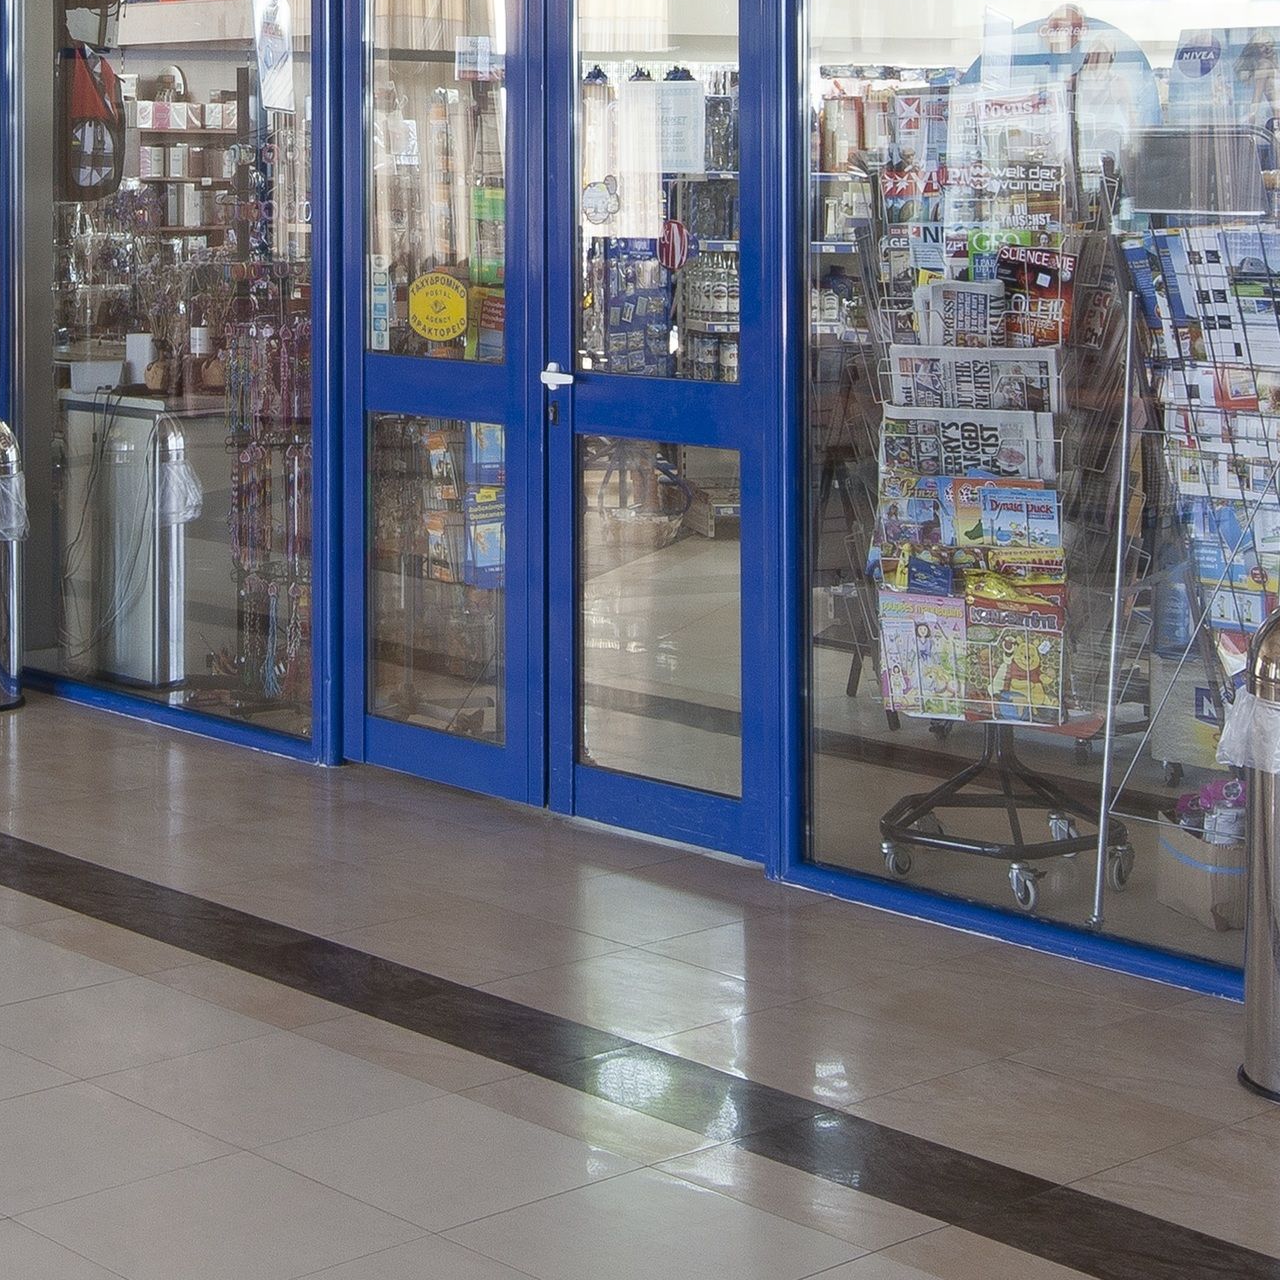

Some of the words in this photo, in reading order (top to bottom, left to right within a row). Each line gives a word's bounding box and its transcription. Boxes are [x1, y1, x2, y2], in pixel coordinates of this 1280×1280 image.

[1039, 24, 1088, 38] Carroten
[1181, 50, 1216, 62] NIVEA
[990, 165, 1026, 178] welt
[1028, 166, 1057, 180] der
[1013, 203, 1027, 215] DU
[972, 232, 1021, 252] GEO
[1000, 245, 1050, 267] SCIENCE
[1056, 255, 1075, 271] VIE
[410, 275, 466, 299] ΤΑΧΥΔΡΟΜΙΚΟ
[425, 289, 452, 300] POSTAL
[425, 315, 452, 324] AGENCY
[1011, 293, 1064, 322] OLEIL
[411, 313, 466, 338] ΠΡΑΚΤΟΡΕΙΟ
[943, 300, 954, 346] XPRESS
[955, 361, 971, 385] THE
[972, 360, 990, 408] RIGHTS?
[961, 422, 981, 476] ANGED
[980, 424, 1000, 476] ACIST
[989, 499, 1024, 513] Donald
[1026, 502, 1054, 514] Duck
